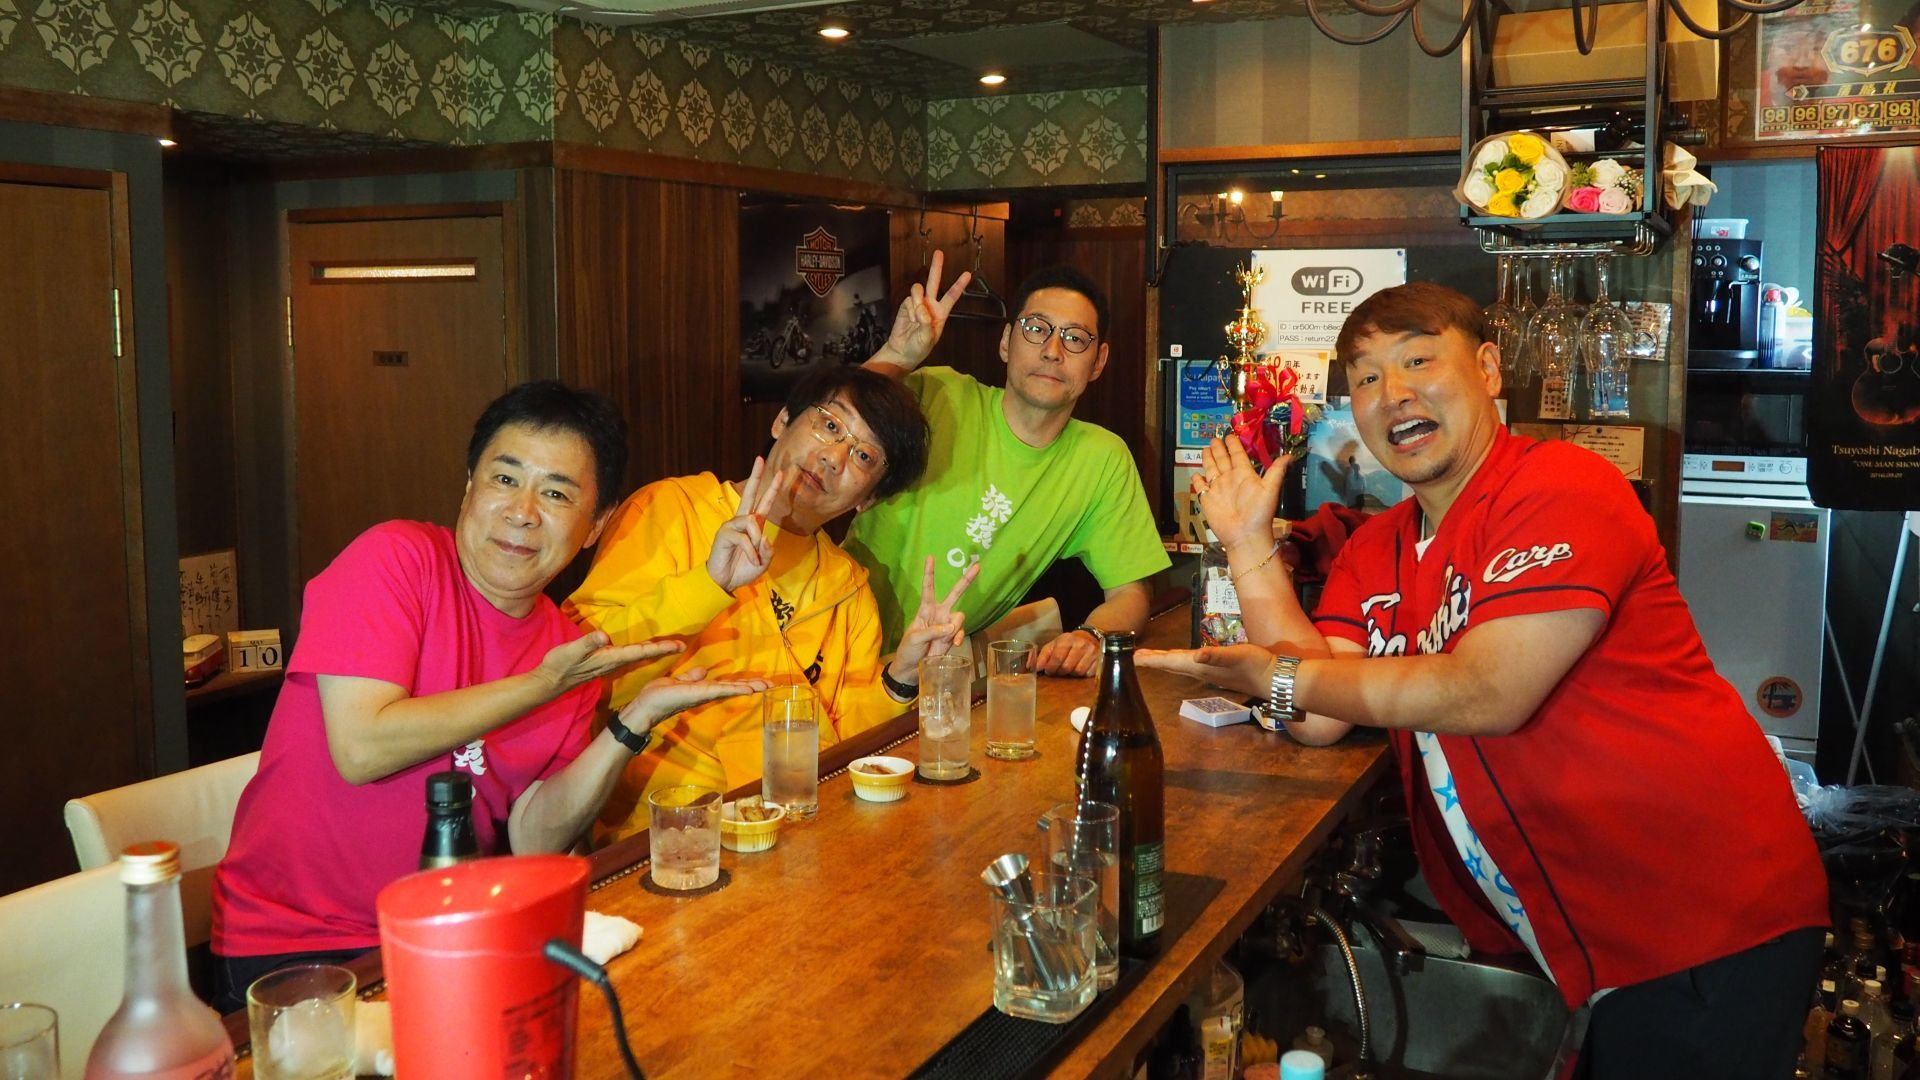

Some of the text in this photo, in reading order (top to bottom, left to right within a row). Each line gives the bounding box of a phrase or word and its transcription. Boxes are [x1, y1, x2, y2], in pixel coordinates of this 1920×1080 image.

[1840, 37, 1897, 64] 676
[1764, 102, 1911, 123] 98 96 97 97 96
[799, 253, 841, 269] HARLEY-DAVIDSON
[1301, 301, 1352, 314] FREE
[1832, 444, 1880, 457] Tsuyoshi
[1483, 543, 1573, 582] Carp
